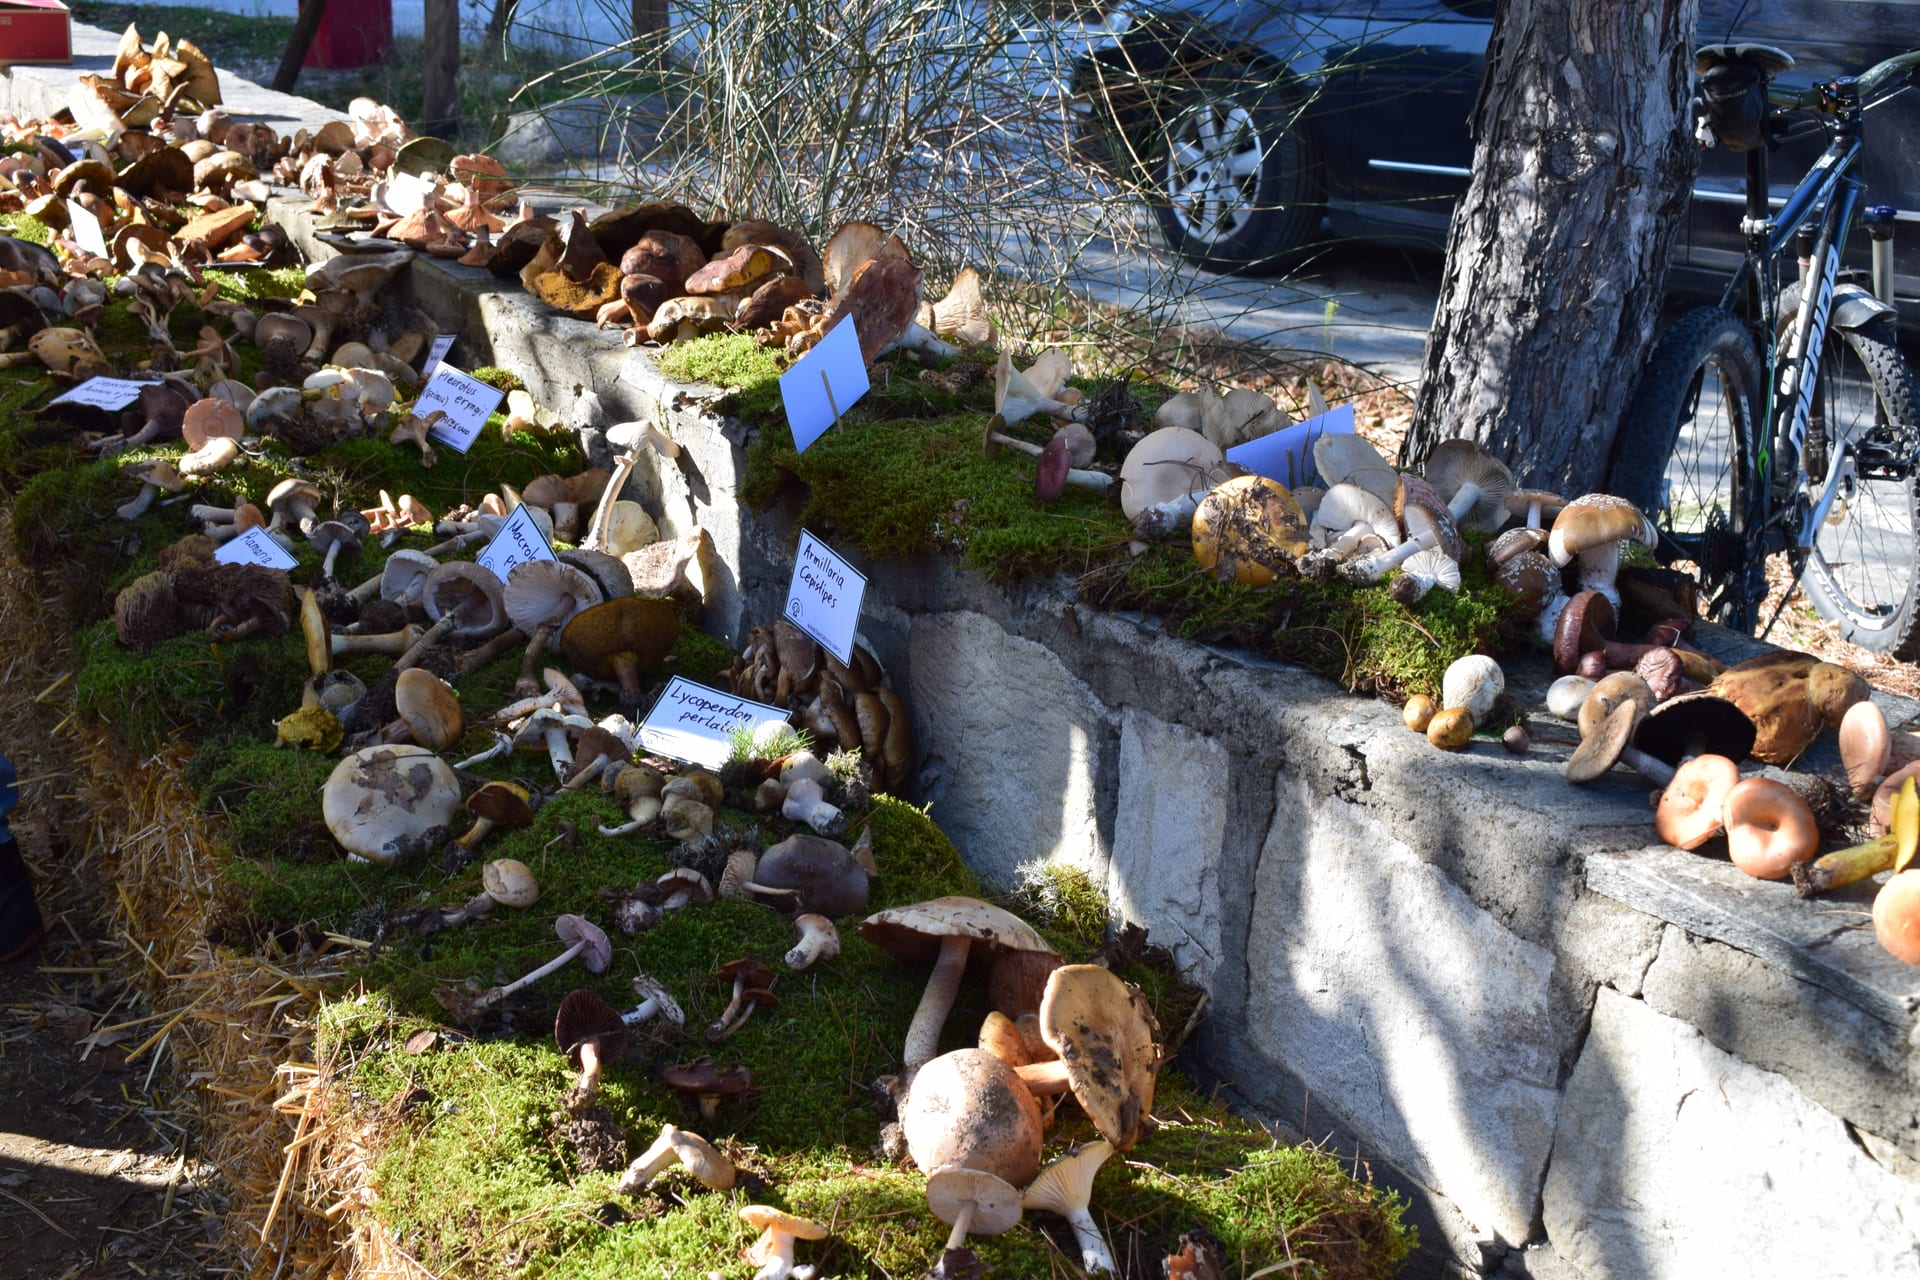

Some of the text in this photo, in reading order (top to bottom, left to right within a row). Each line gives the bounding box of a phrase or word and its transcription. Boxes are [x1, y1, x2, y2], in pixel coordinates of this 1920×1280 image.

[1789, 244, 1839, 459] MERIDA
[437, 369, 478, 396] Pleurotus
[803, 542, 845, 591] Armillaria
[670, 684, 753, 723] Lycoperdon
